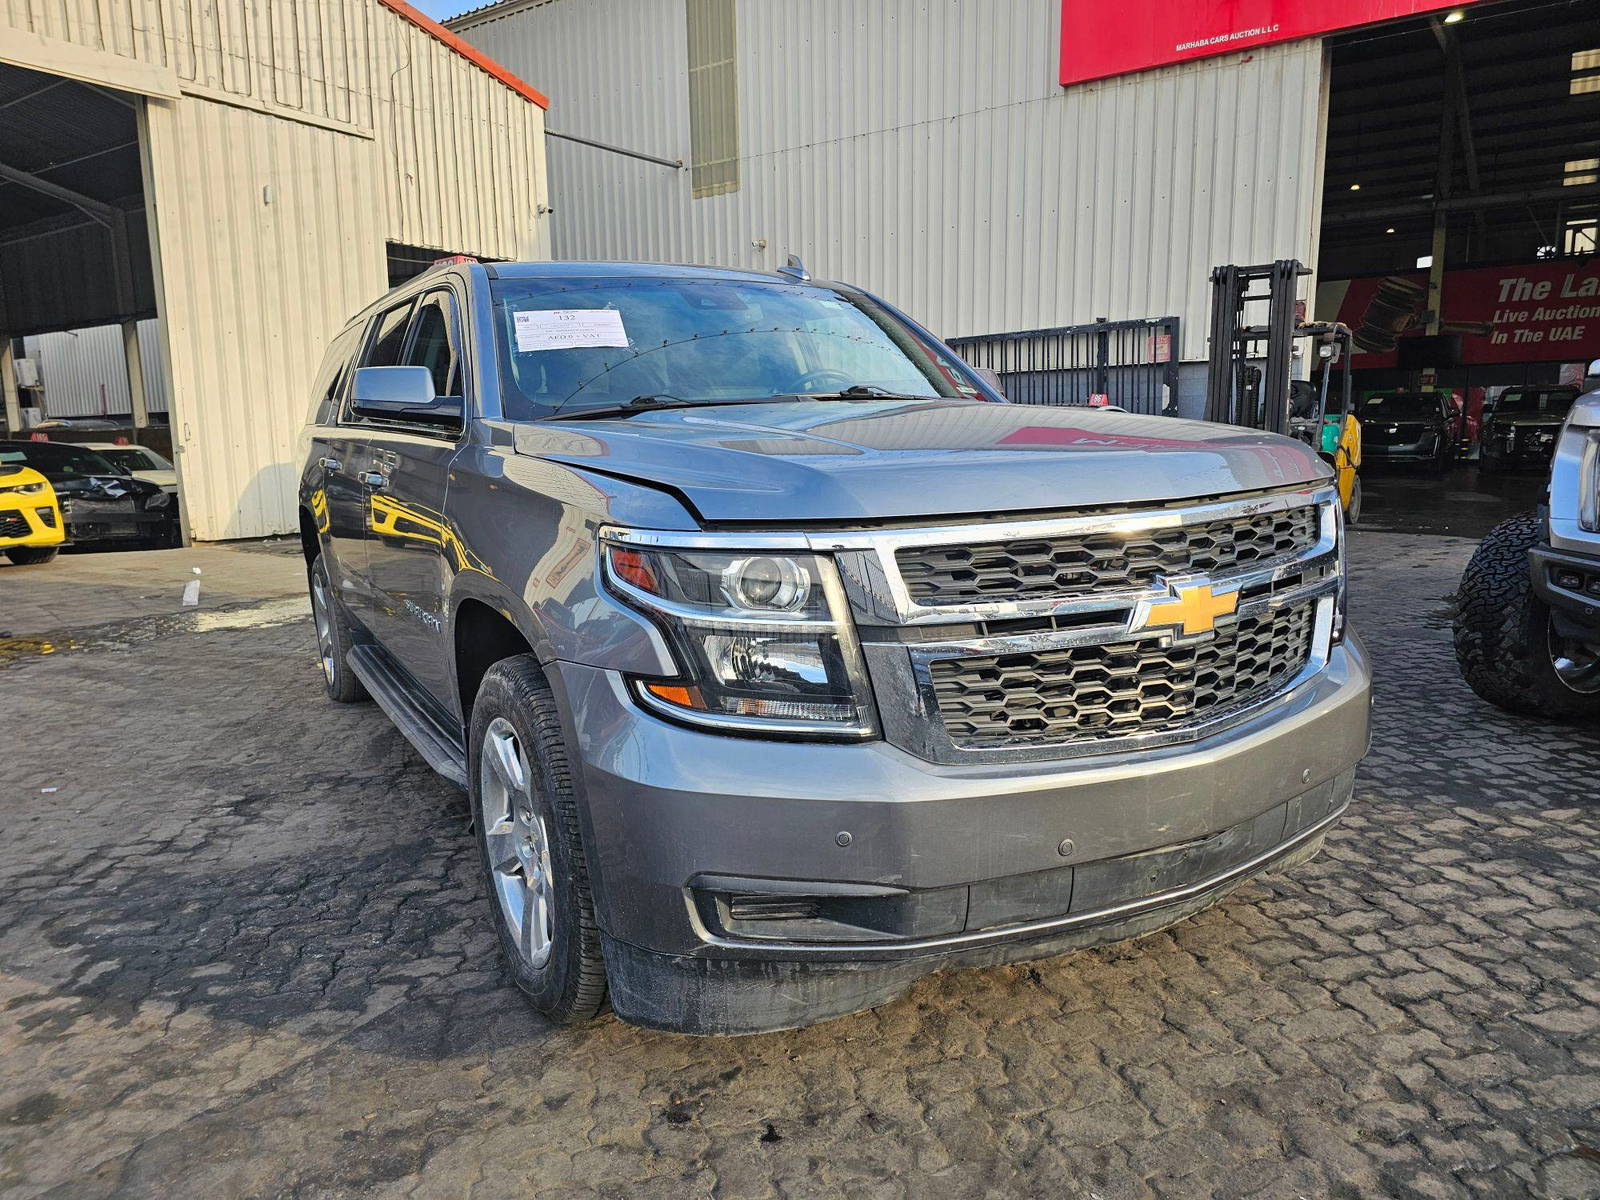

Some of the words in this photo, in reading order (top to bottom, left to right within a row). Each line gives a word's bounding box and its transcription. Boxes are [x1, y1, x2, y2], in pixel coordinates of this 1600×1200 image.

[1176, 40, 1209, 51] MARHABA
[1210, 35, 1229, 44] CARS
[1230, 28, 1260, 40] AUCTION
[1498, 278, 1552, 303] The
[1560, 274, 1600, 298] La
[1493, 310, 1528, 323] Live
[1490, 331, 1509, 344] In
[1513, 329, 1544, 343] The
[1549, 326, 1585, 341] UAE
